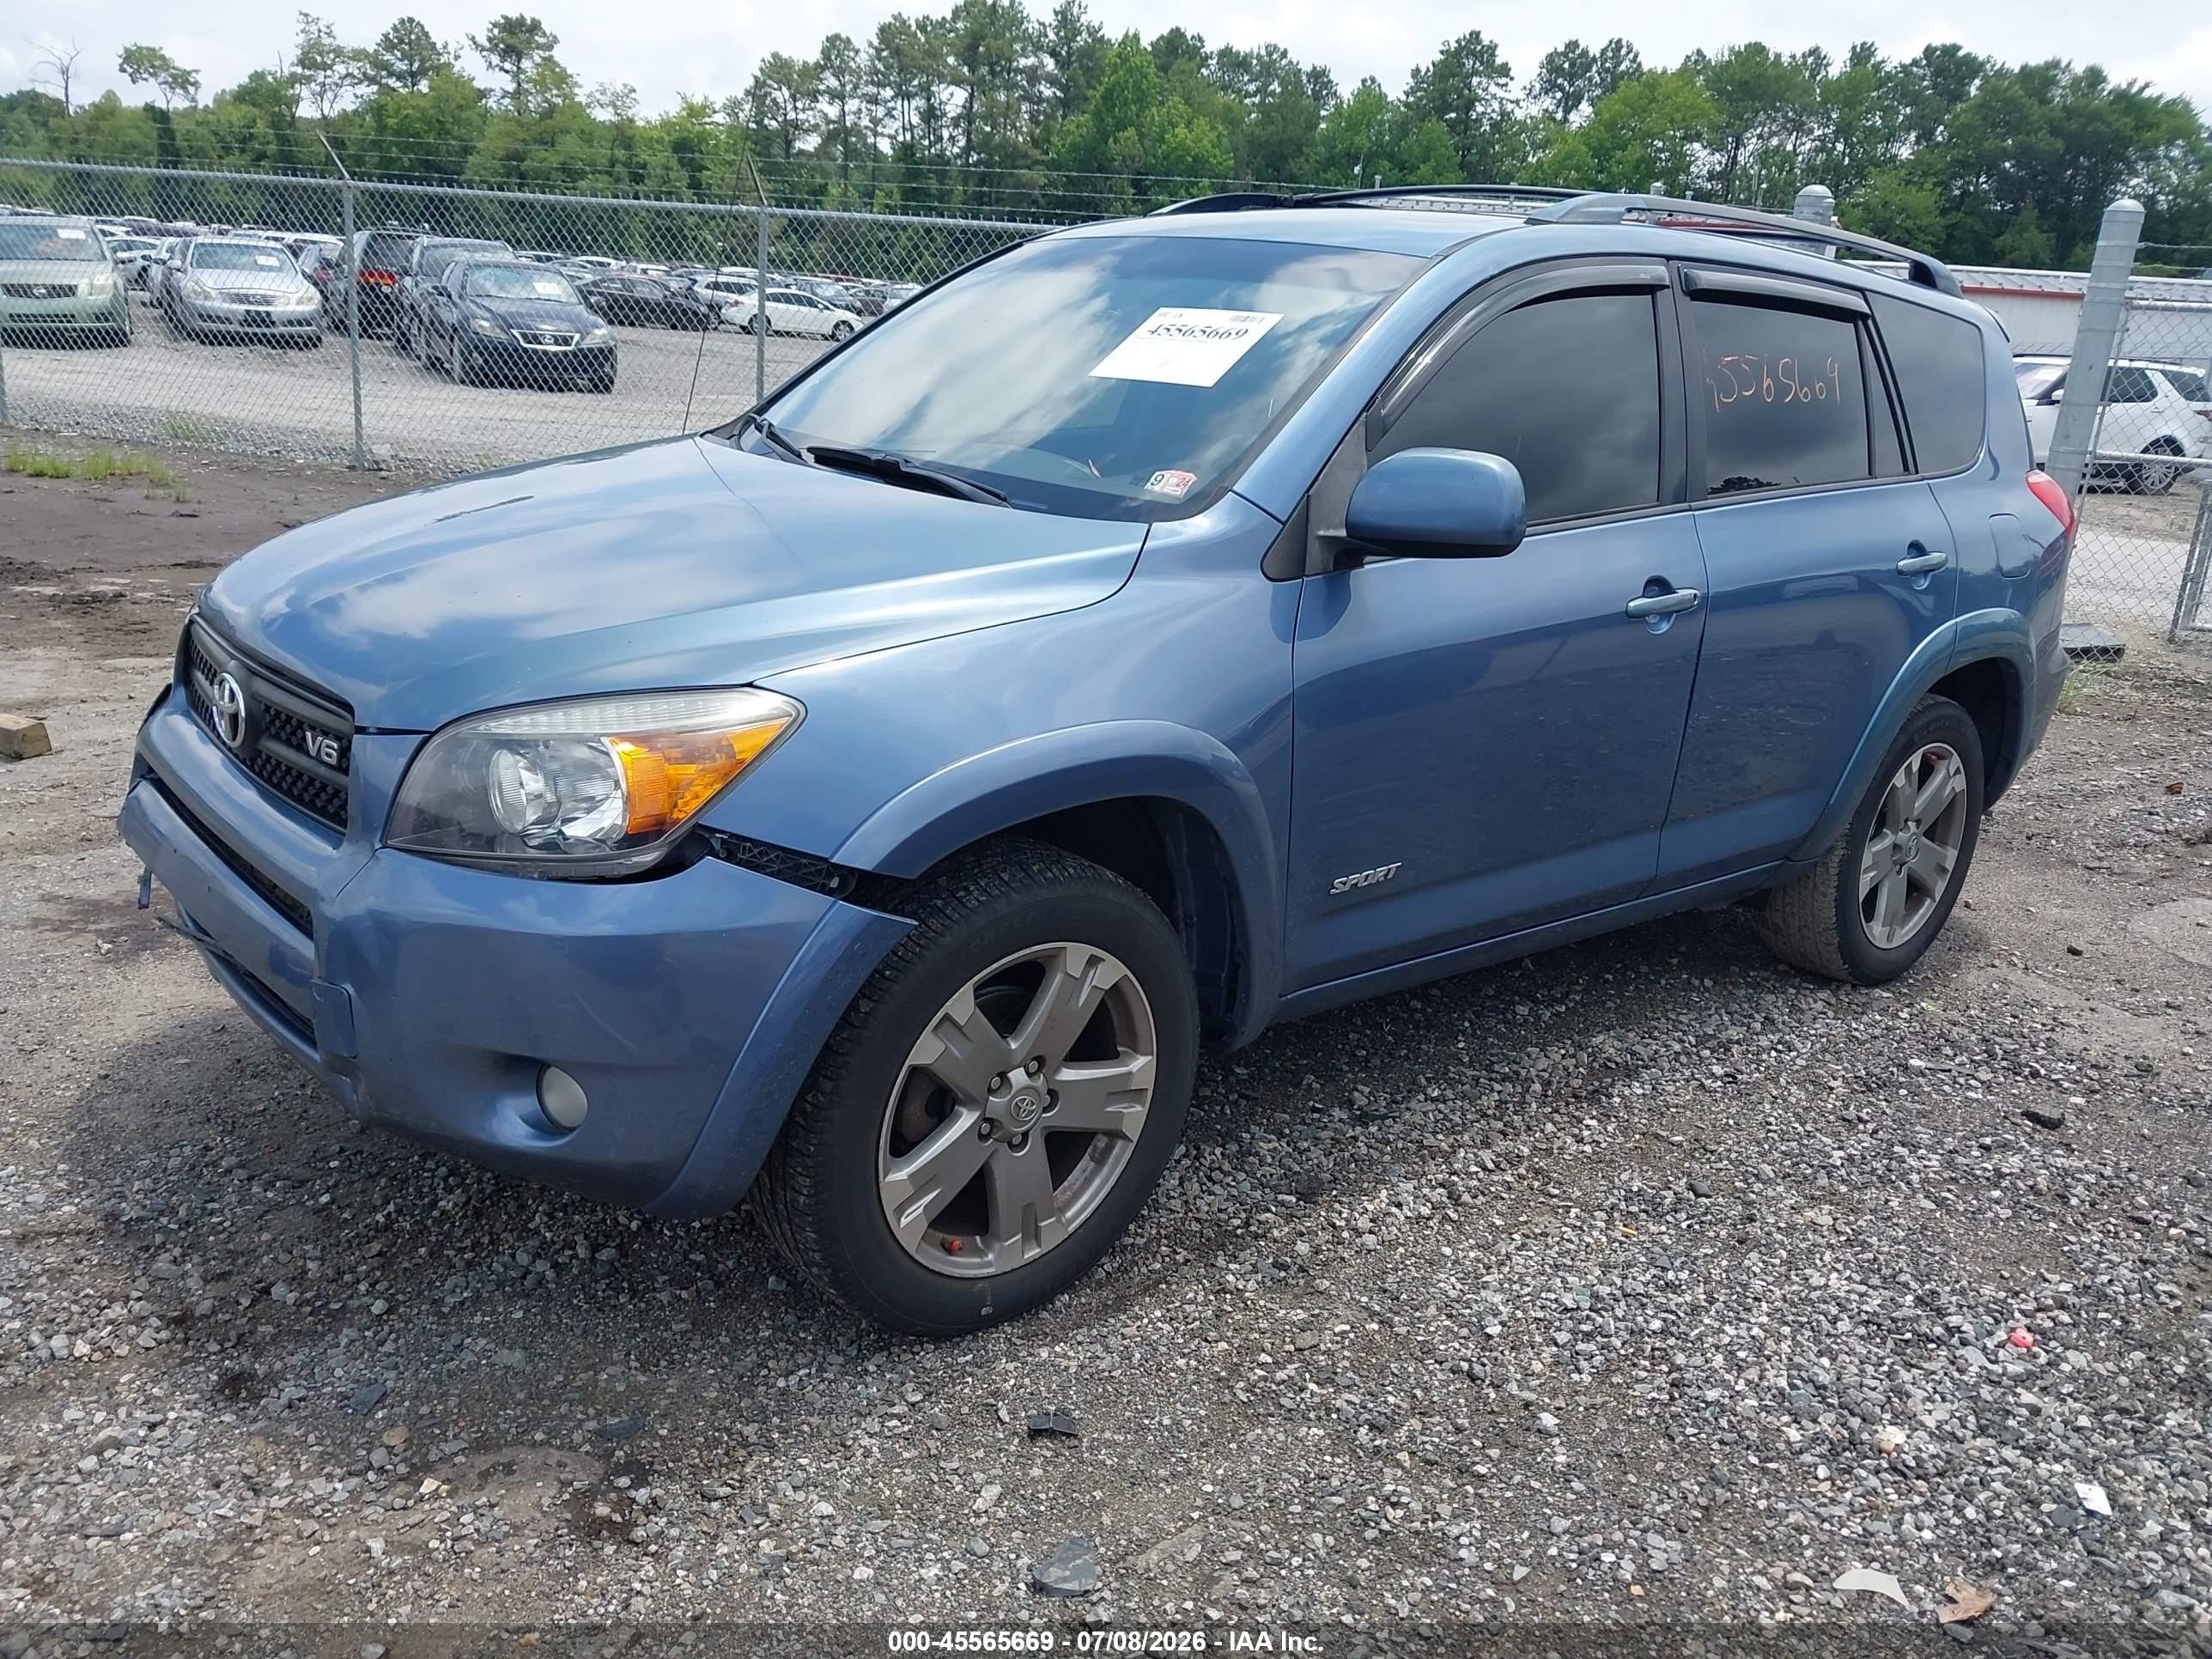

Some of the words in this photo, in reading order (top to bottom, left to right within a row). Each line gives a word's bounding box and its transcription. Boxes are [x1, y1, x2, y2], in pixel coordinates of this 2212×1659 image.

[1147, 323, 1249, 341] 45565669
[1151, 473, 1165, 486] 9
[305, 731, 338, 765] V6
[1329, 861, 1402, 895] SPORT
